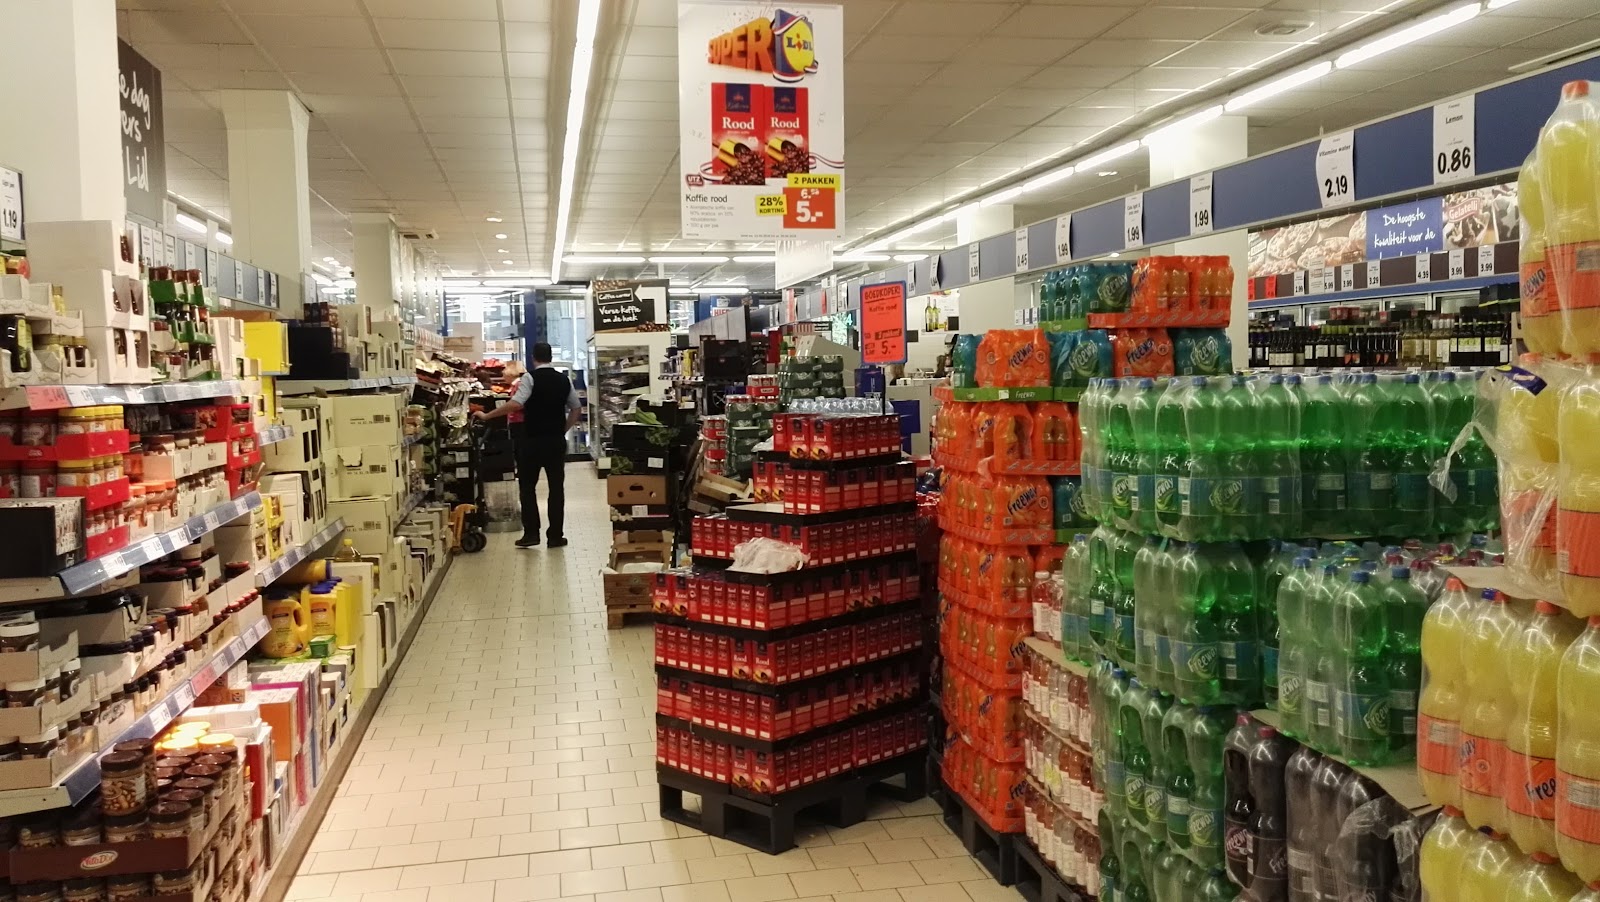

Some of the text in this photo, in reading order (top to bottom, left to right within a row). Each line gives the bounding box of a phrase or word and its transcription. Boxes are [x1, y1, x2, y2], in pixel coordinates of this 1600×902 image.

[707, 16, 775, 74] SUPER
[722, 116, 755, 130] Rood
[770, 116, 800, 129] Rood
[1445, 114, 1464, 124] Lemon
[126, 145, 149, 192] Lidl
[1437, 146, 1471, 175] 0.86
[1324, 175, 1348, 198] 2.19
[685, 194, 728, 203] Koffie rood
[759, 196, 784, 206] 28%
[796, 200, 823, 222] 5.-
[1383, 214, 1396, 226] De
[1397, 207, 1426, 227] hoogste
[1449, 200, 1478, 220] Gelatelli
[3, 208, 18, 229] 1.19
[1194, 209, 1209, 228] 1.99
[1127, 225, 1140, 243] 1.99
[1407, 232, 1423, 243] voor
[1424, 228, 1436, 239] de
[1480, 263, 1493, 272] 3.99
[599, 304, 620, 315] Verse
[1126, 338, 1155, 364] Freeway
[1007, 487, 1038, 515] Freeway
[733, 654, 748, 662] Rood
[755, 657, 770, 666] Rood
[734, 761, 748, 770] Rood
[755, 766, 769, 775] Rood
